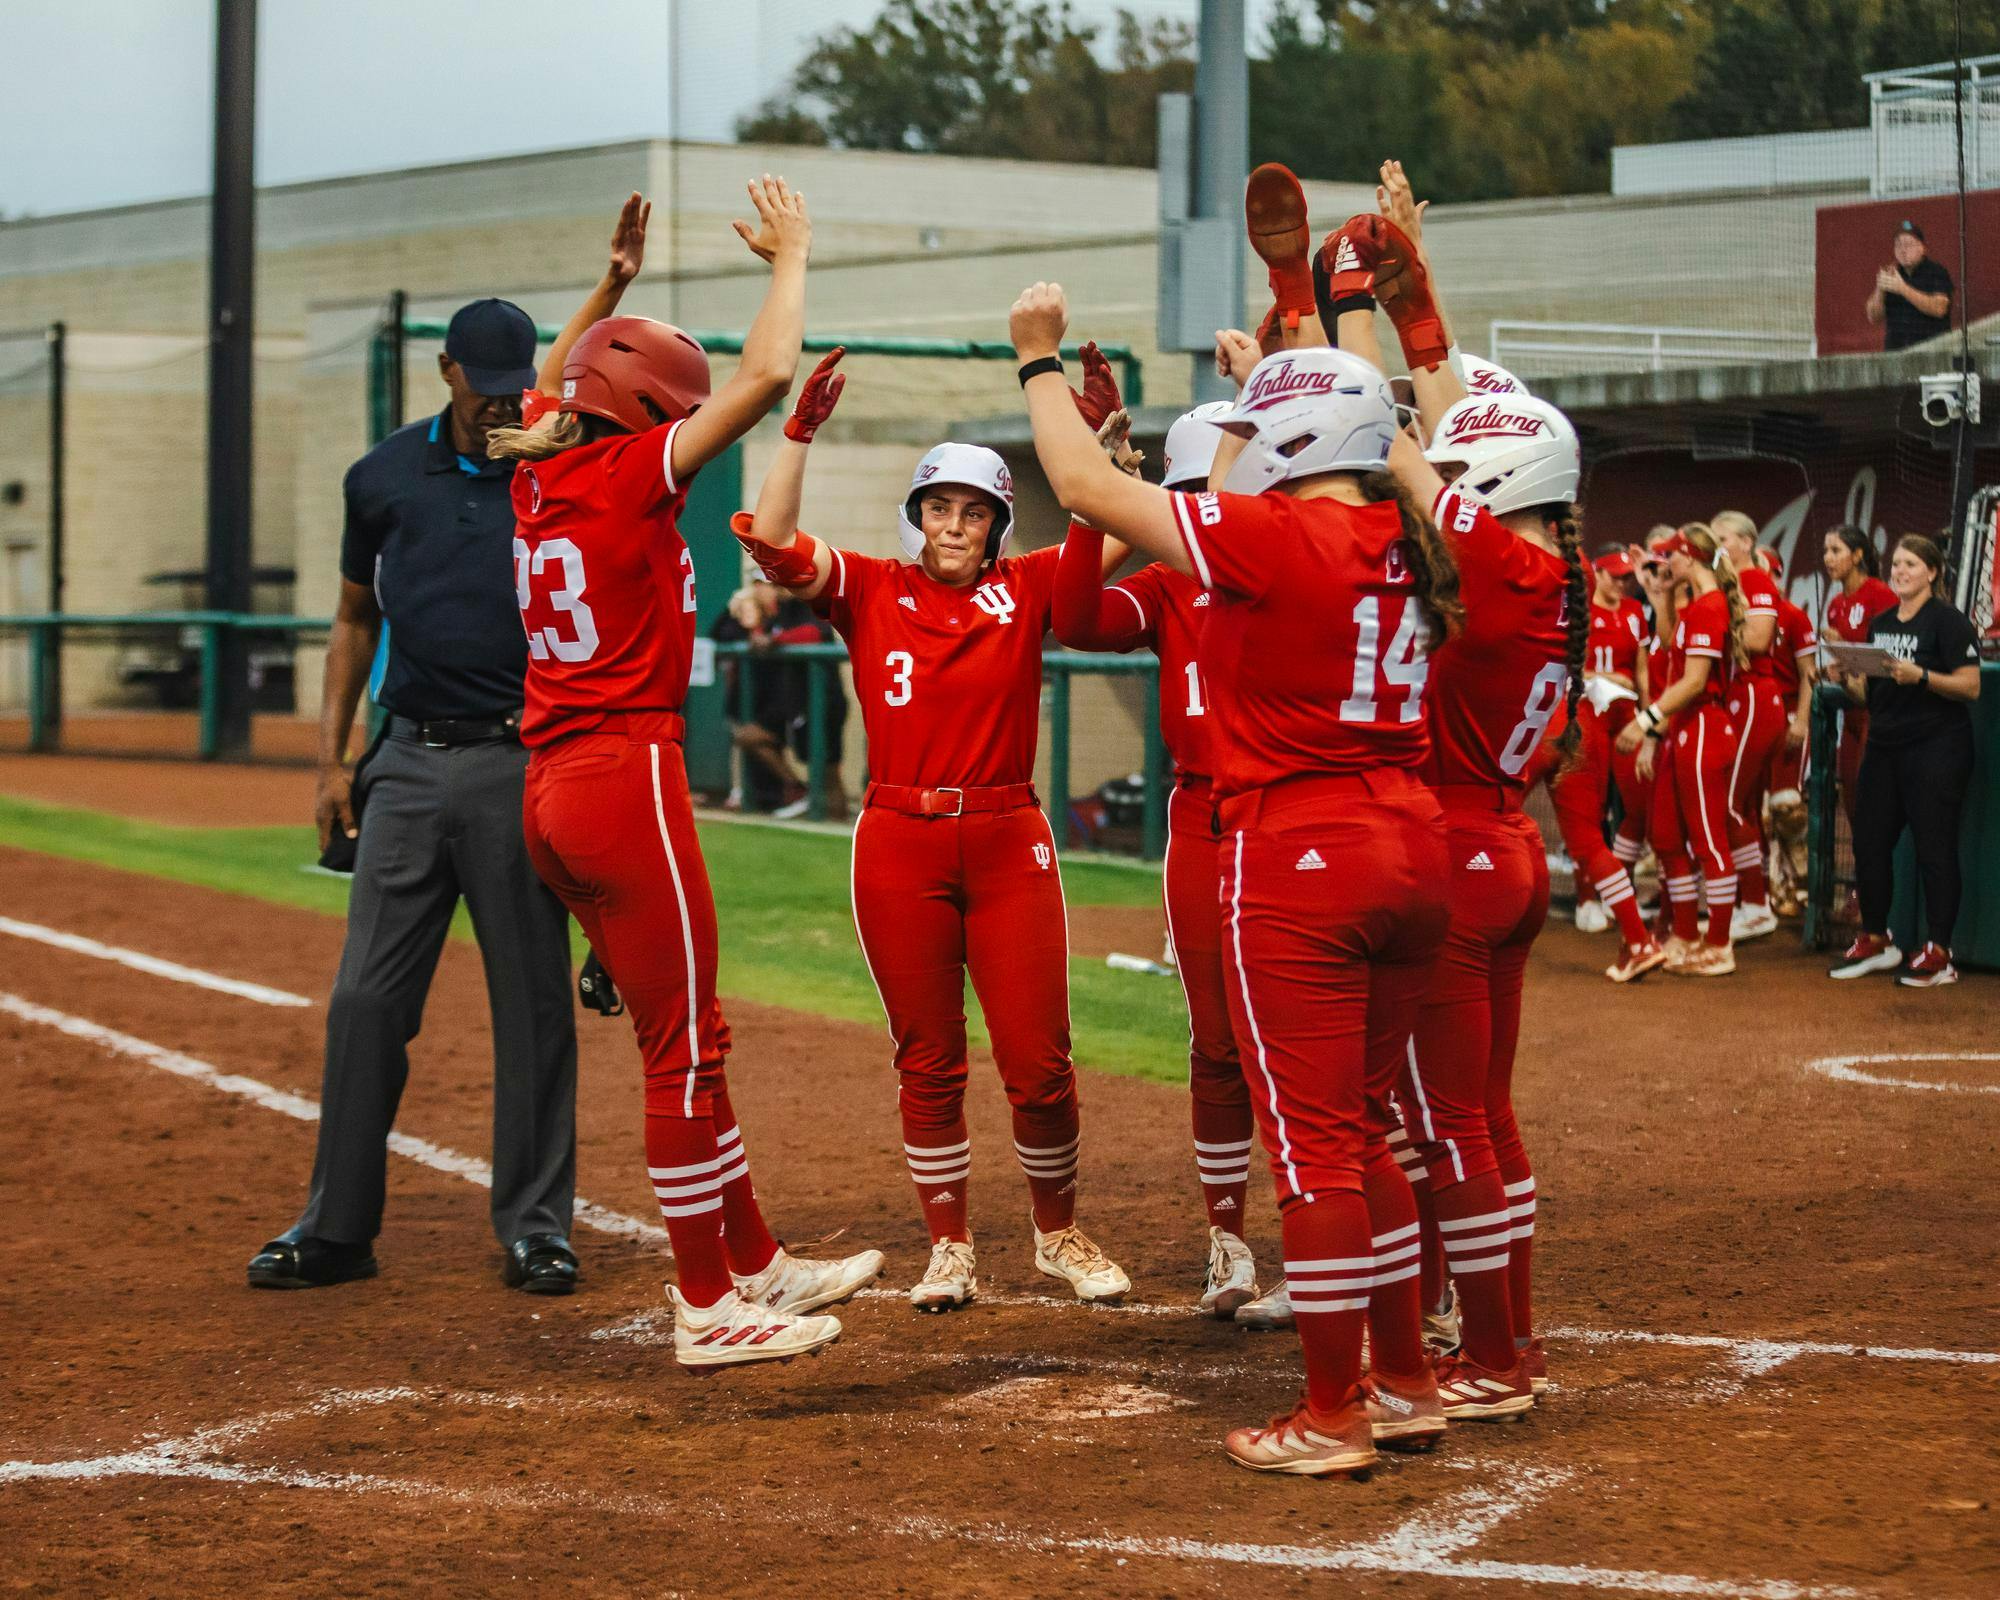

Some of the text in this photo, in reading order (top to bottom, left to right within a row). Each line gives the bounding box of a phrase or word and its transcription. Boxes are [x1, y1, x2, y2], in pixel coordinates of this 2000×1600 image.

[1242, 362, 1338, 410] Indiana
[1444, 403, 1544, 440] Indiana
[512, 536, 600, 662] 23
[884, 650, 914, 708] 3
[1338, 595, 1430, 723] 14
[1499, 661, 1568, 775] 8
